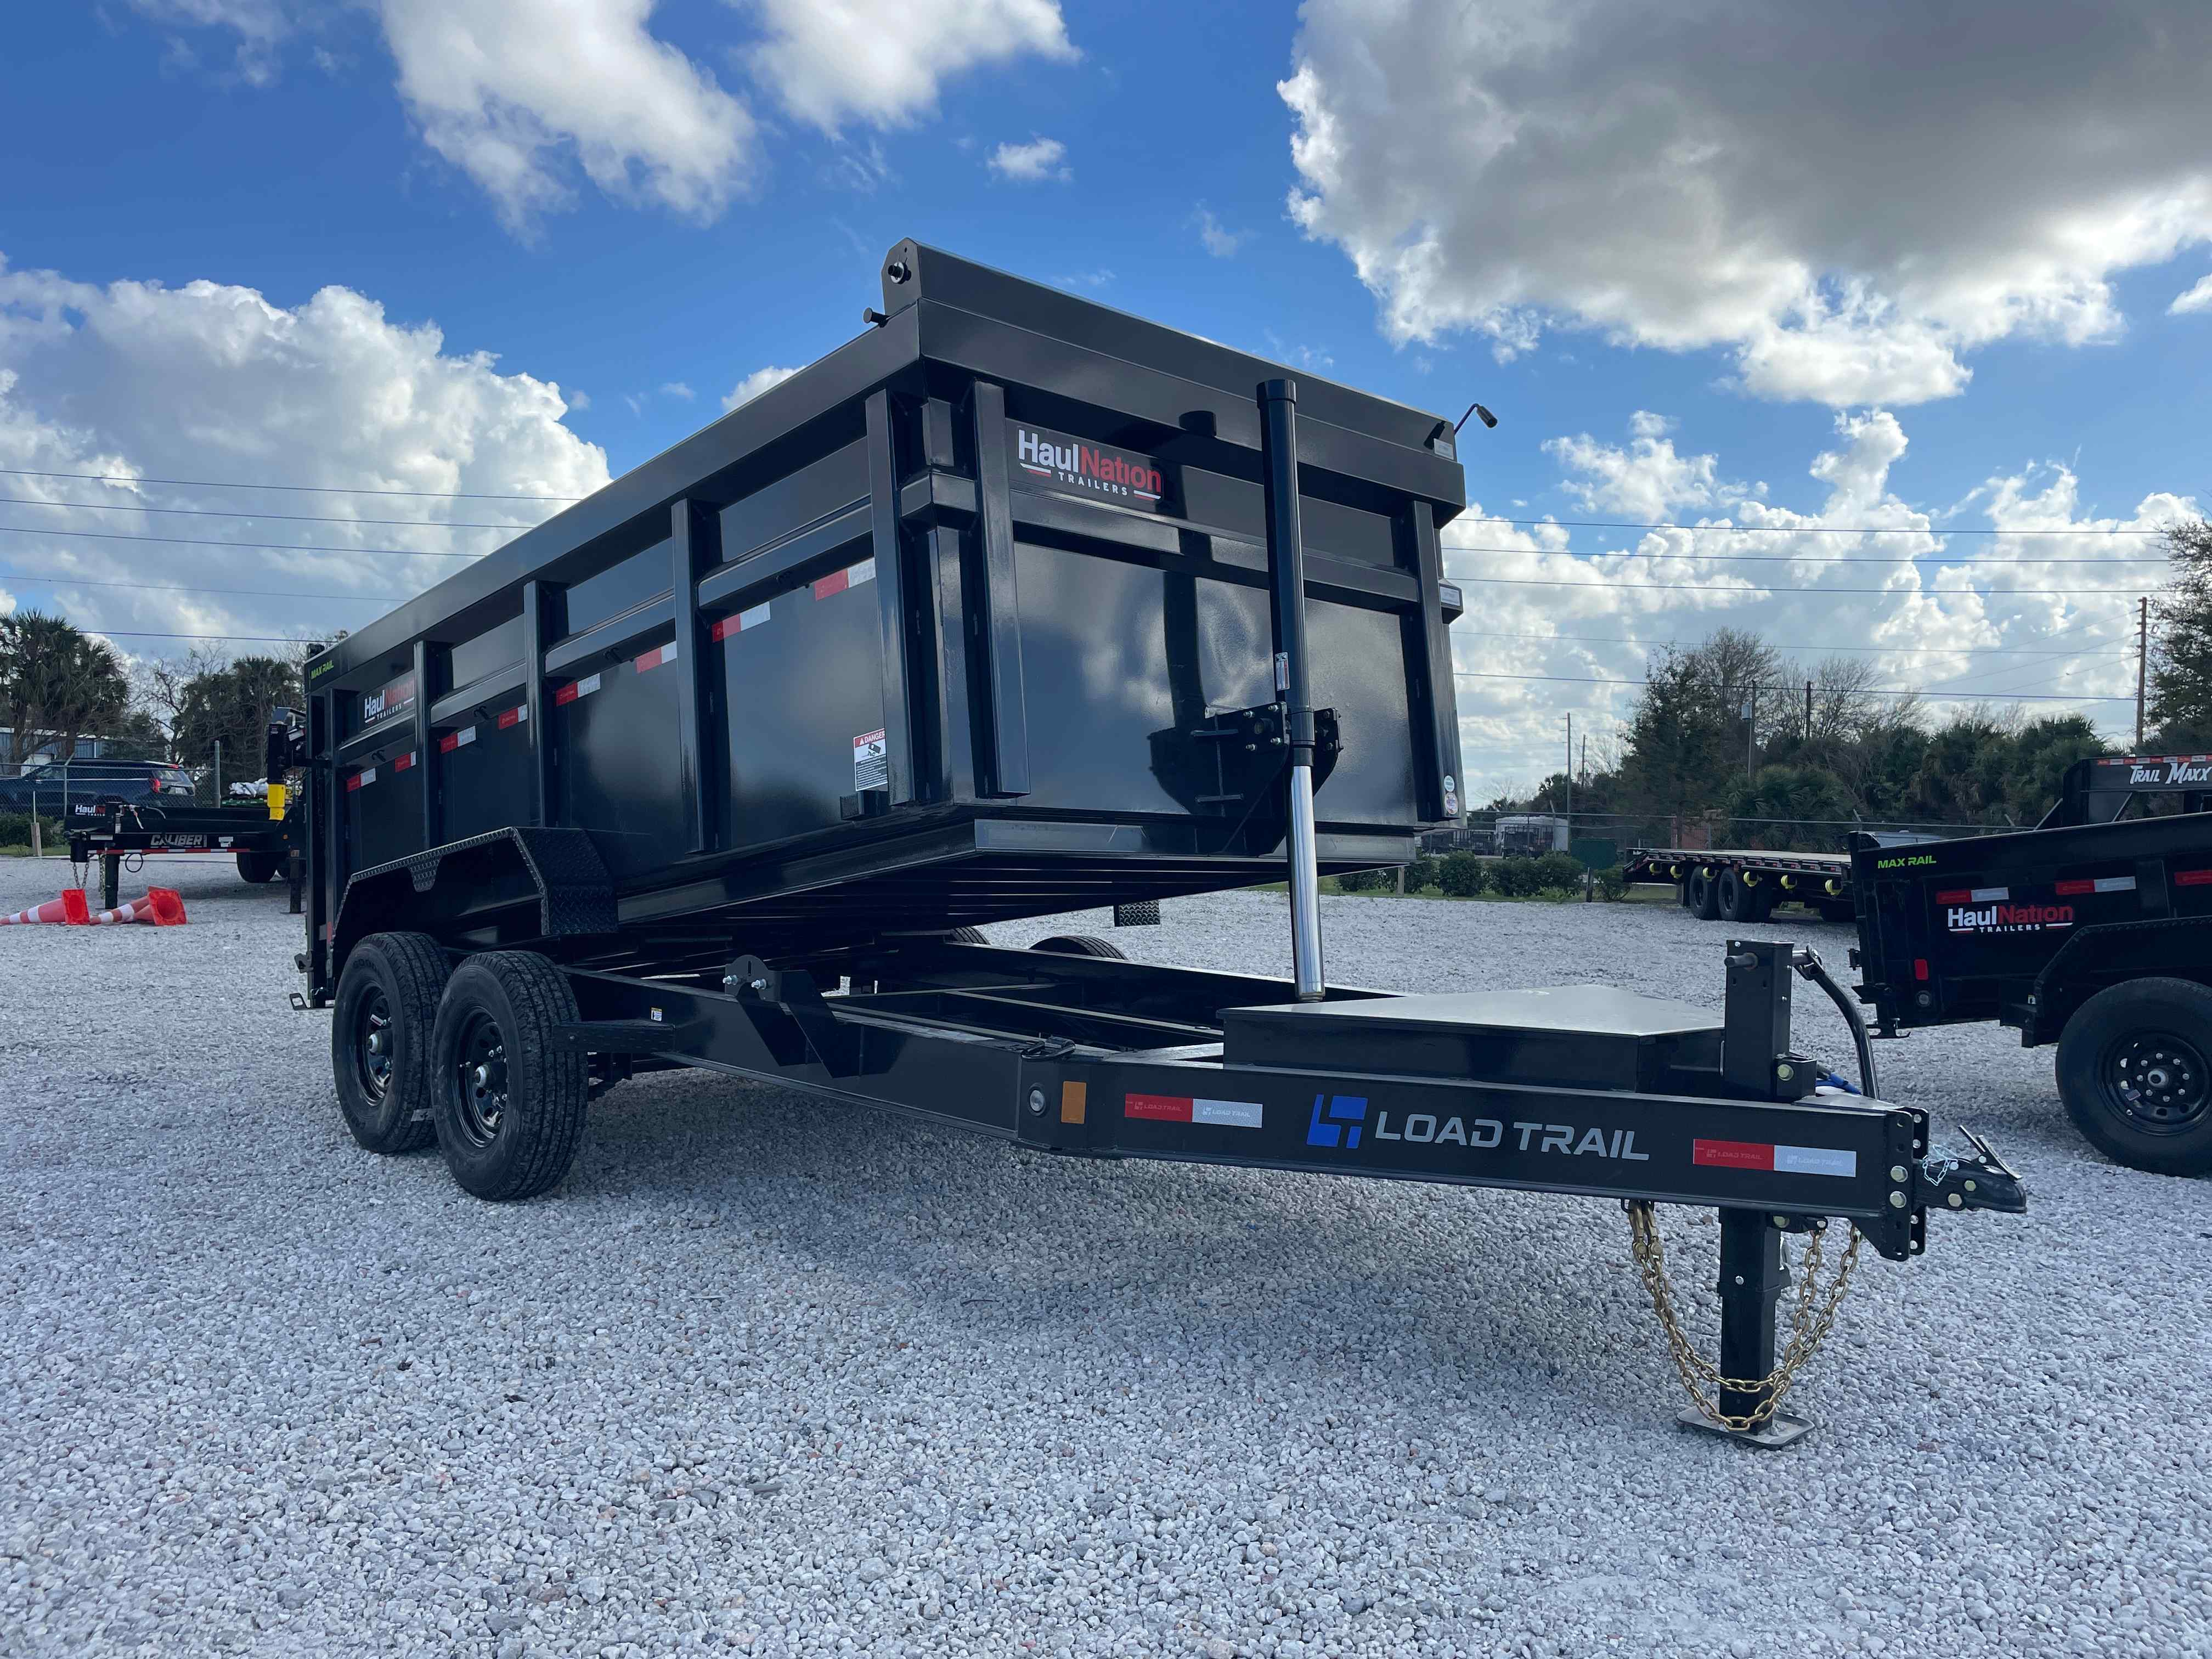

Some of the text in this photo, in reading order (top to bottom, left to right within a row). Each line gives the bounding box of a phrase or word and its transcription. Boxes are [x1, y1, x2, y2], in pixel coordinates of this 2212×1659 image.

[1018, 430, 1161, 492] HaulNation
[1058, 472, 1128, 496] TRAILERS
[311, 666, 323, 680] MAX
[377, 703, 402, 720] TRAILERS
[2130, 763, 2212, 784] TRAIL MAXX
[150, 834, 202, 845] CALIBER
[1878, 855, 1937, 868] MAX RAIL
[1948, 905, 2073, 927] HaulNation
[1979, 923, 2040, 933] TRAILERS
[1375, 1111, 1503, 1148] LOAD
[1513, 1122, 1649, 1160] TRAIL
